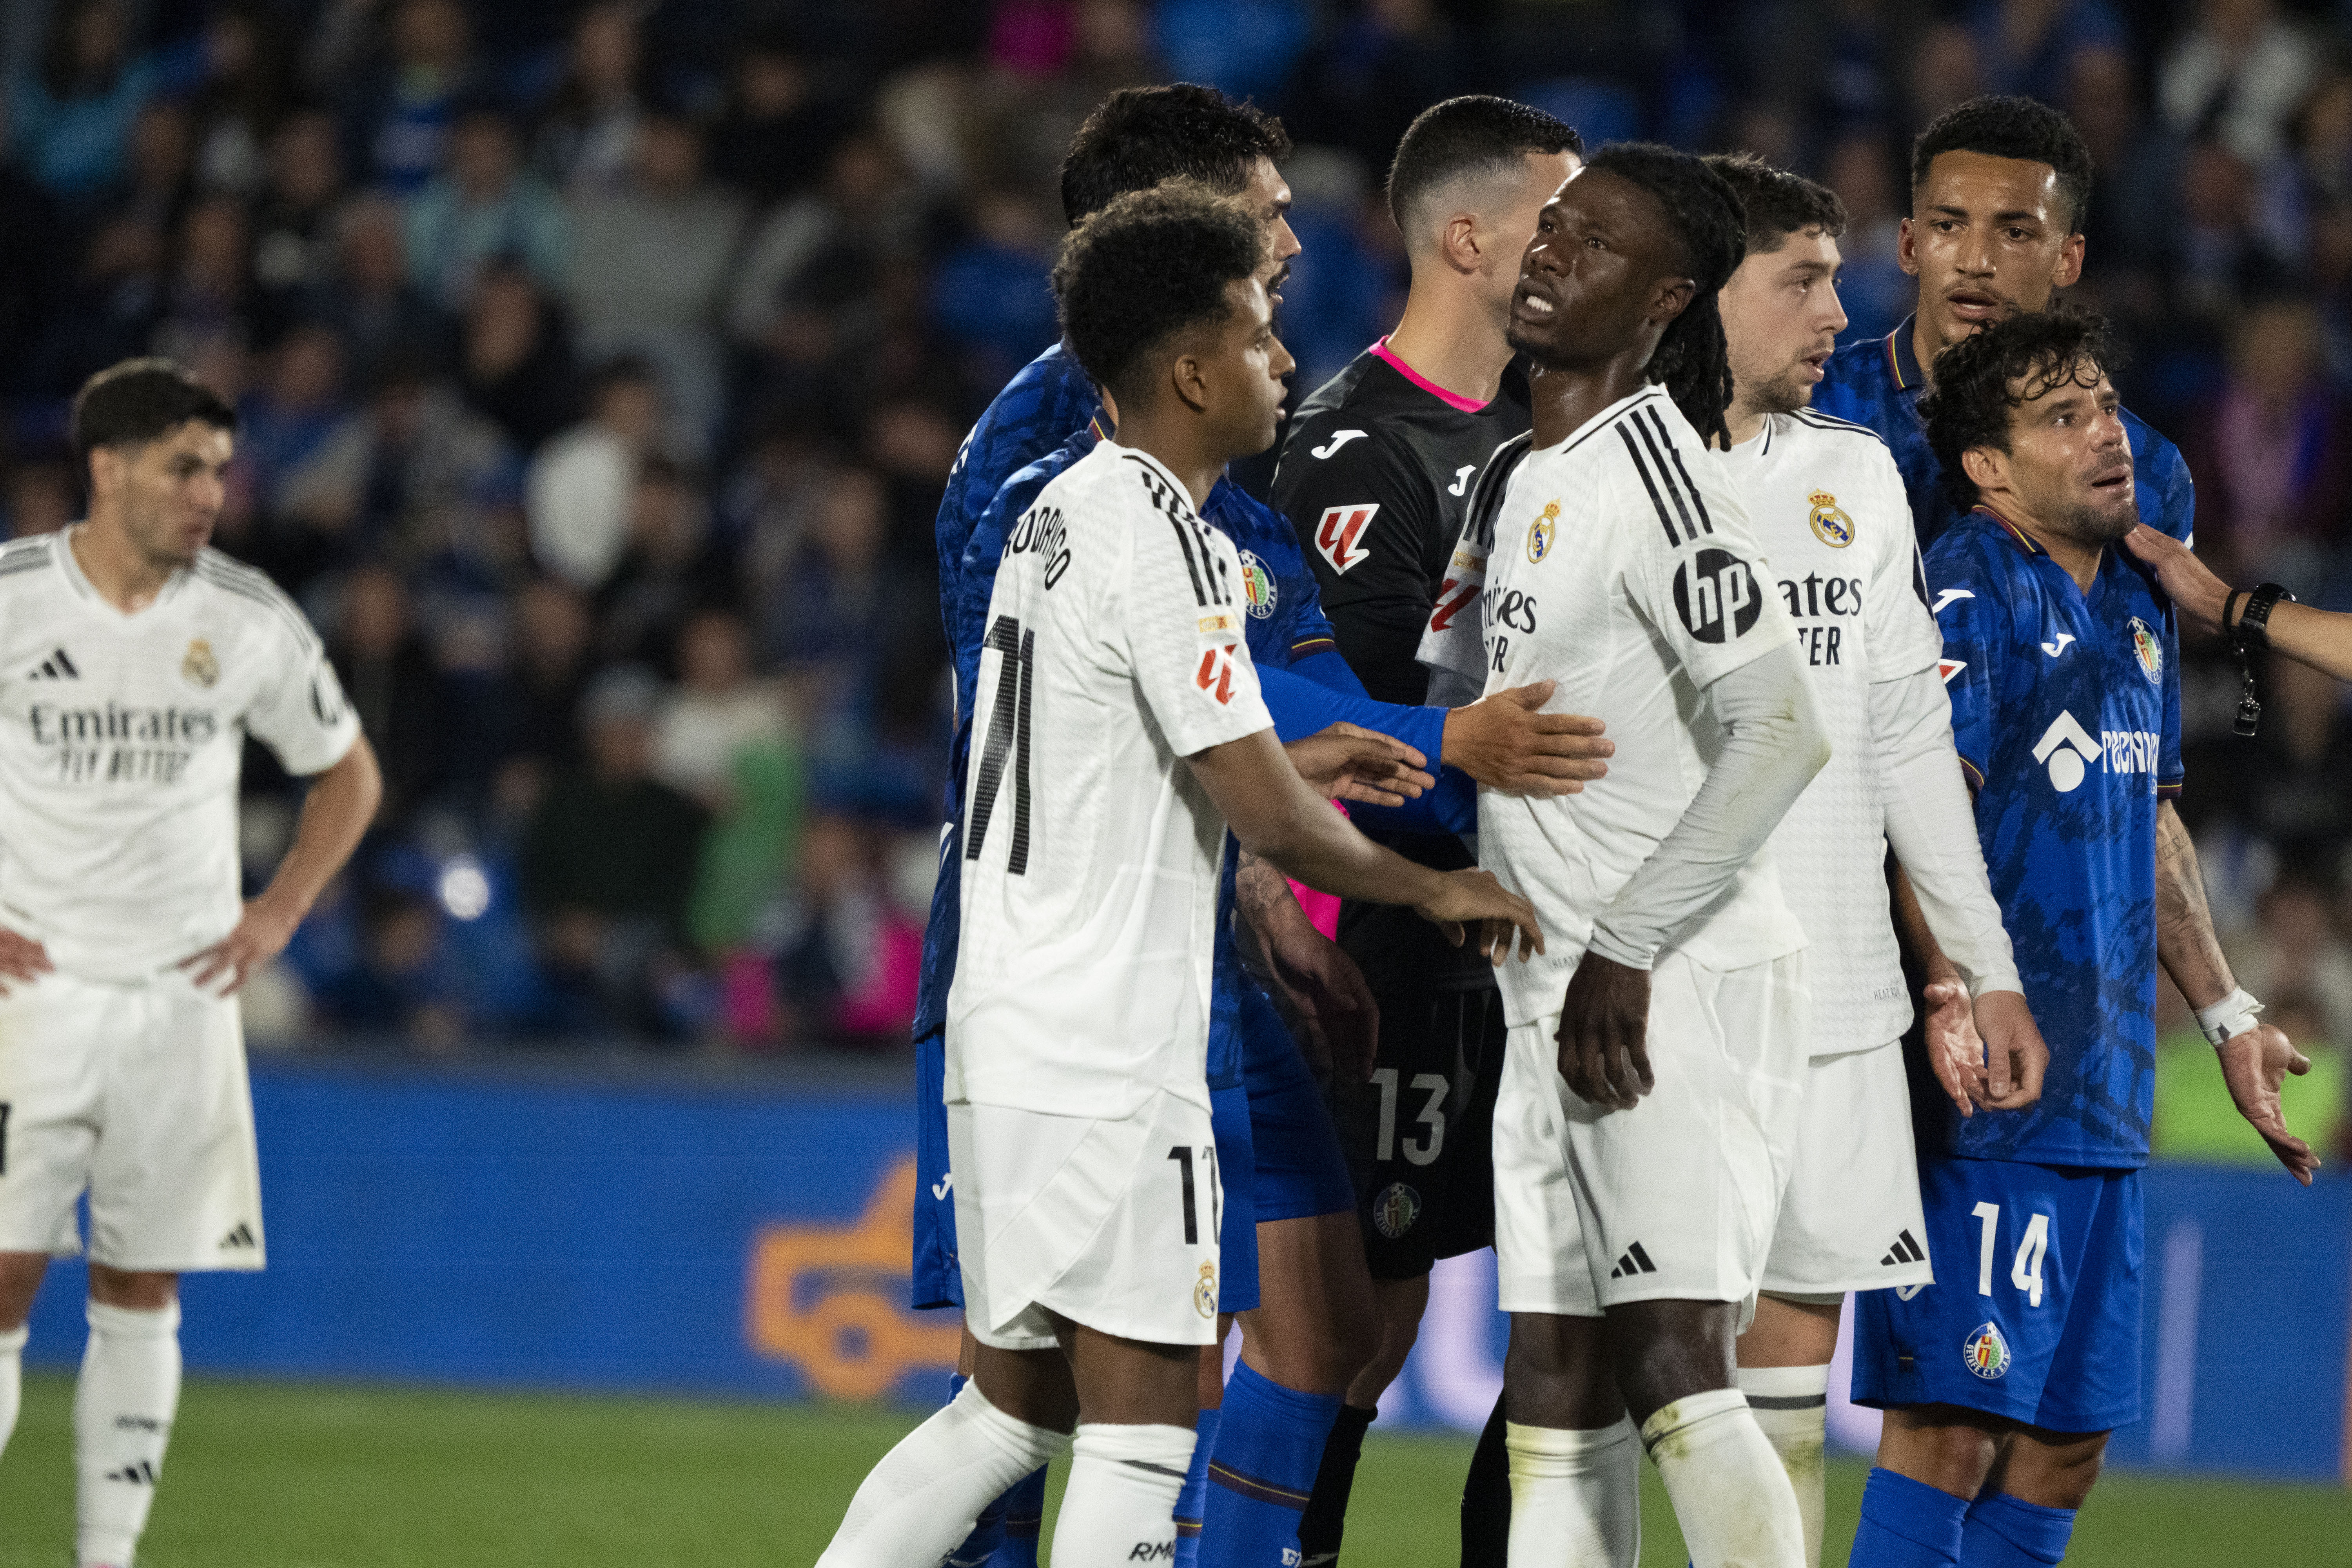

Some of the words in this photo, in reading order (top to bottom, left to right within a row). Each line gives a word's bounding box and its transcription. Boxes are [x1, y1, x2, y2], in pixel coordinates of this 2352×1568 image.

[965, 614, 1035, 876] 11
[1368, 1068, 1449, 1165] 13
[1167, 1146, 1220, 1245] 11
[1971, 1201, 2049, 1308] 14
